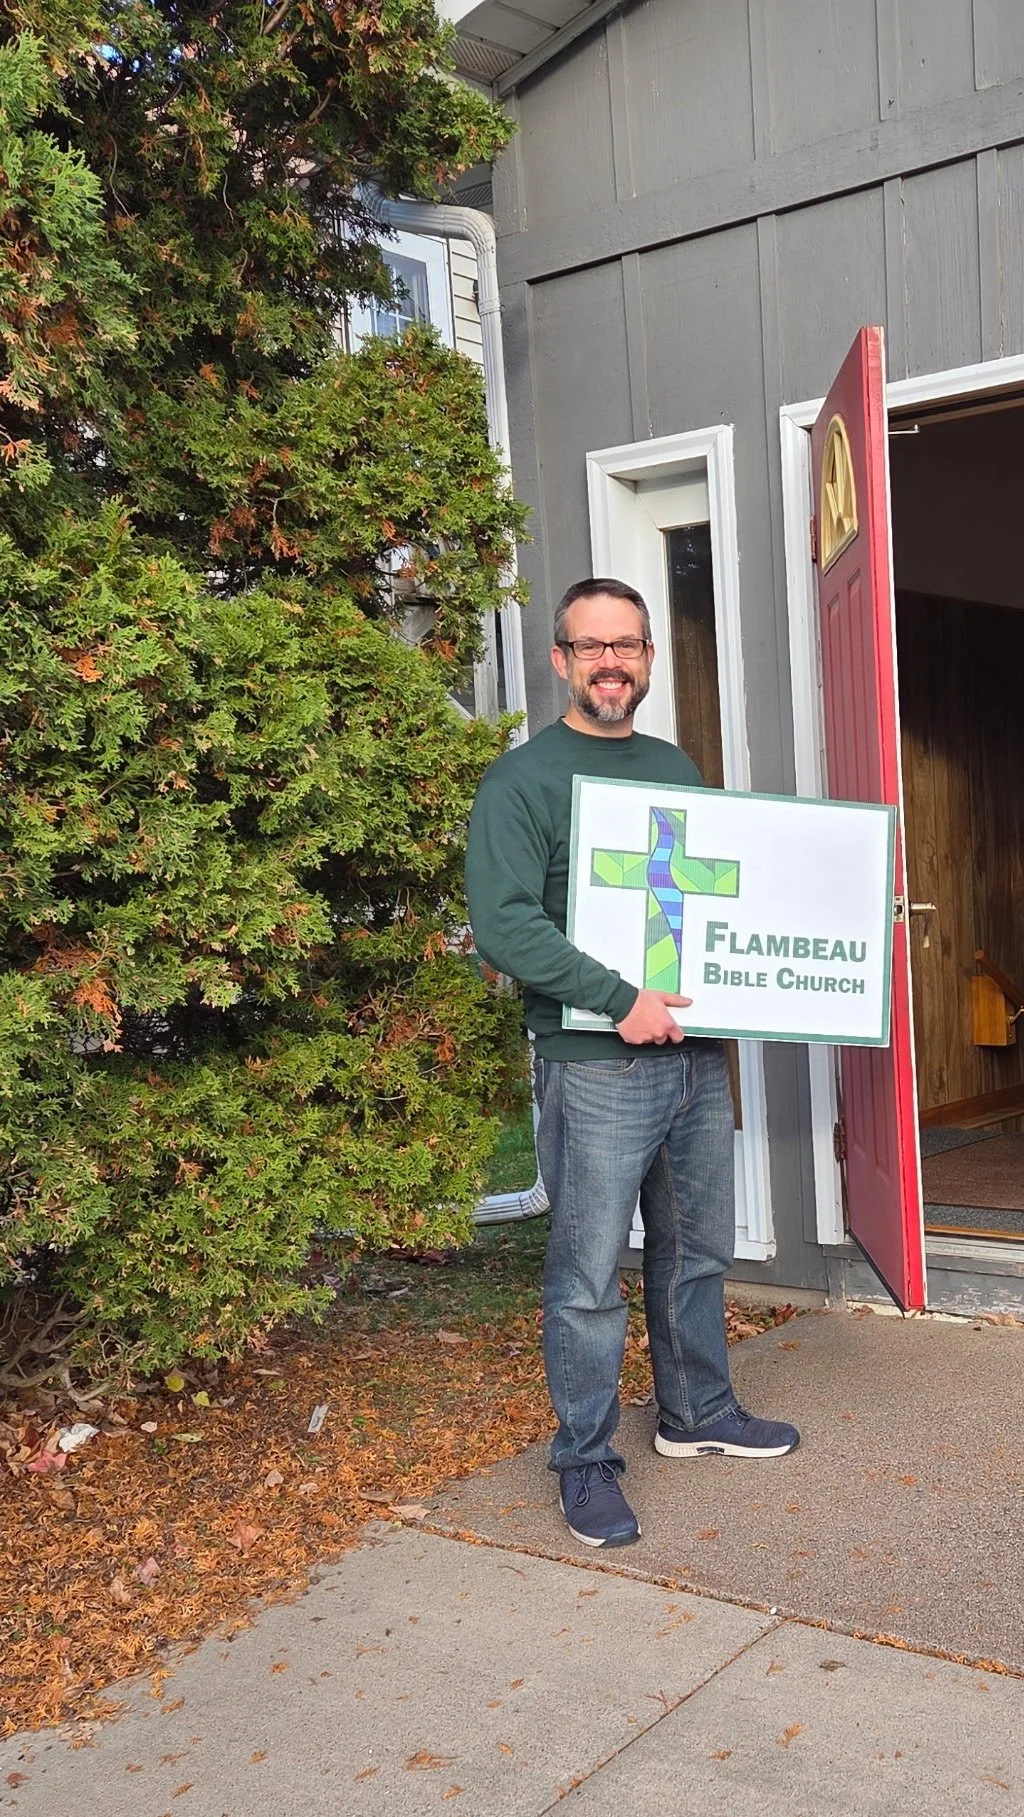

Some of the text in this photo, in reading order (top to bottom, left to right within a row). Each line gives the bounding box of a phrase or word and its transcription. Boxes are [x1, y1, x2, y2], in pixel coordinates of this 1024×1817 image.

[705, 921, 867, 963] FLAMBEAU
[703, 962, 865, 995] BIBLE CHURCH
